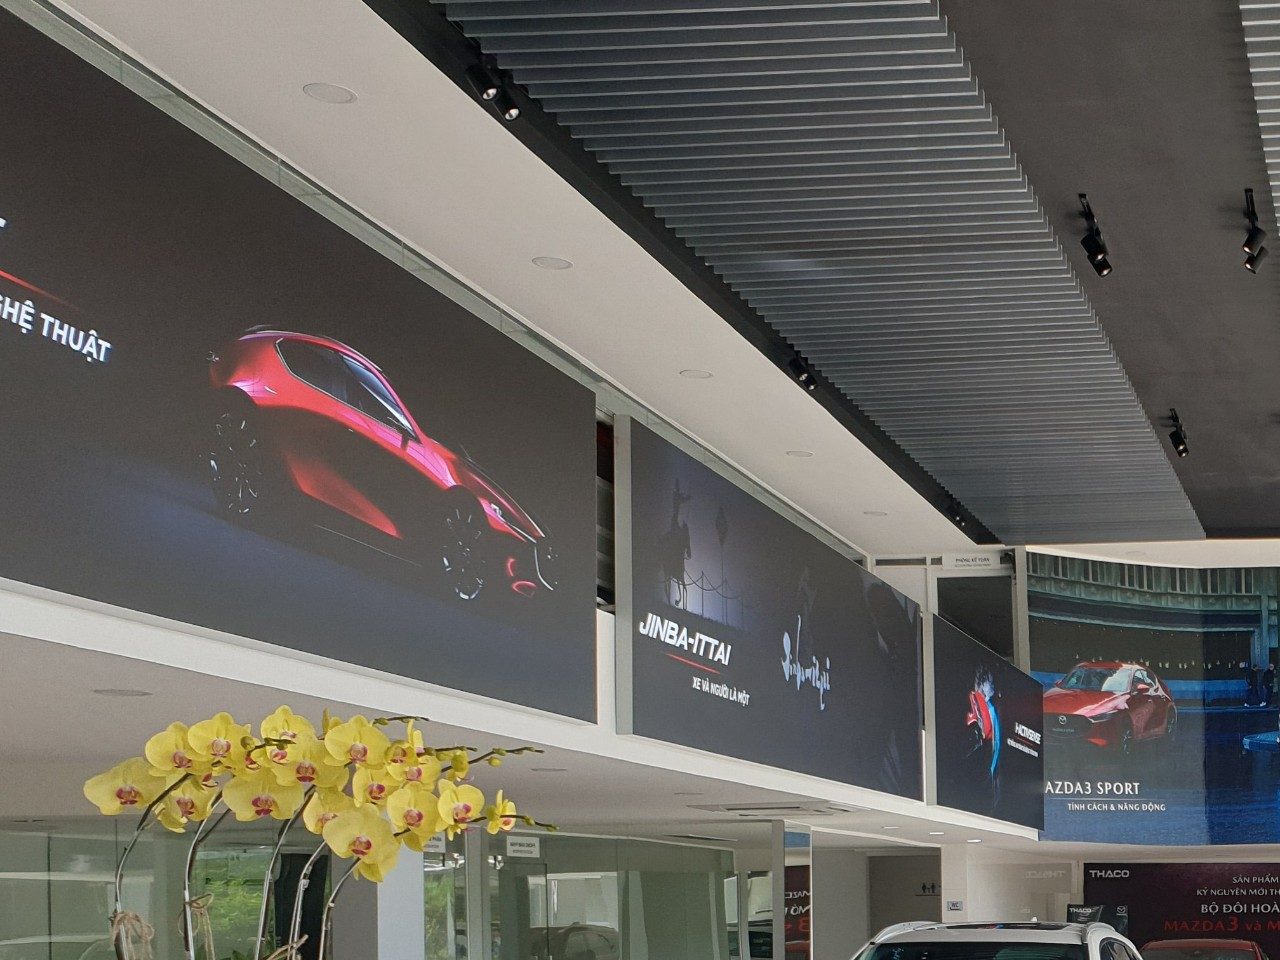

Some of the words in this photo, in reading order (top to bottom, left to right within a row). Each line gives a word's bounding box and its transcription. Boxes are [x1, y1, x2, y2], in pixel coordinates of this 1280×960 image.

[0, 294, 35, 334] HỆ
[40, 312, 112, 362] THUẬT
[639, 612, 732, 666] JINBA-ITTAI
[692, 676, 701, 690] XE
[702, 677, 710, 693] VÀ
[729, 687, 737, 701] LÀ
[1097, 781, 1140, 795] SPORT
[1068, 802, 1085, 811] TÍNH
[1087, 802, 1108, 811] CÁCH
[1142, 802, 1166, 812] ĐỘNG
[1089, 869, 1130, 878] THACO
[1232, 874, 1250, 883] SẢN
[1252, 873, 1279, 884] PHẨM
[1211, 888, 1247, 896] NGUYÊN
[1249, 888, 1267, 896] MỚI
[1201, 902, 1219, 915] BỘ
[1223, 902, 1247, 913] ĐÔI
